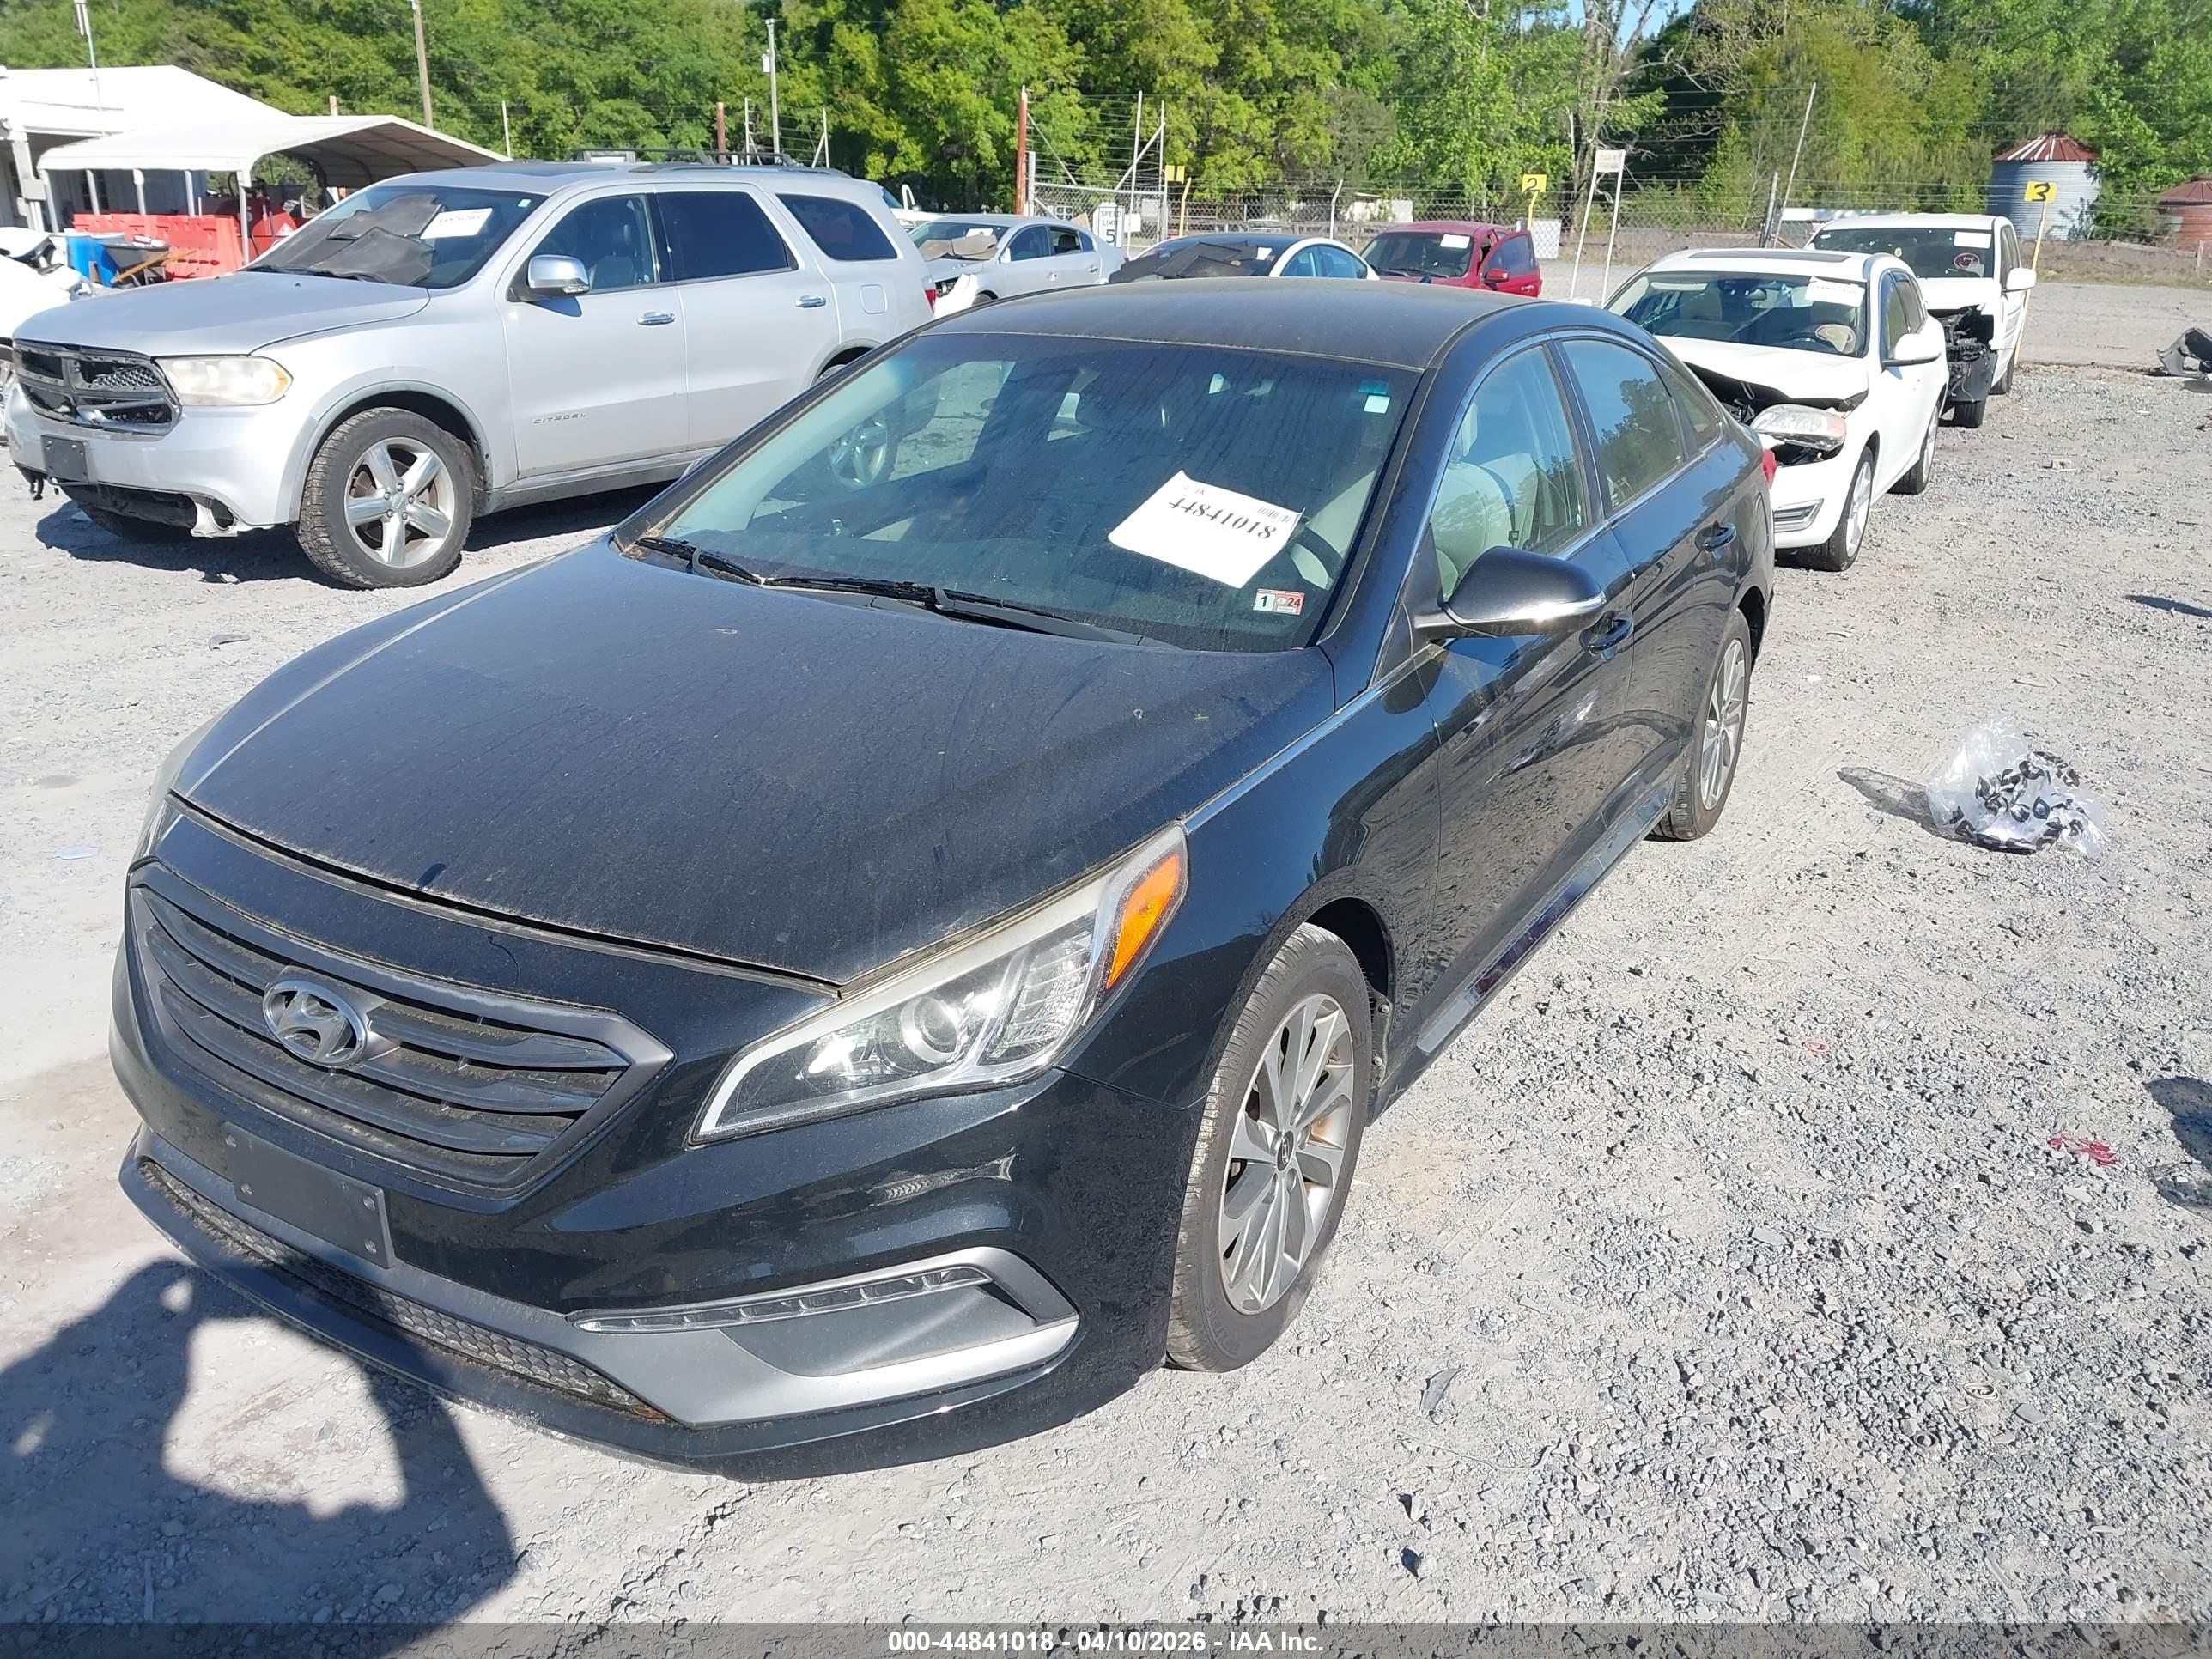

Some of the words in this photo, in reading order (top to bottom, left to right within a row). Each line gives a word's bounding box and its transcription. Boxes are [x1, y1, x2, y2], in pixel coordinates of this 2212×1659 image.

[1525, 177, 1540, 192] 2
[2033, 182, 2051, 202] 3
[1106, 228, 1116, 244] 5
[1169, 497, 1277, 539] 44841018
[1260, 595, 1267, 607] 1
[1287, 597, 1301, 607] 24
